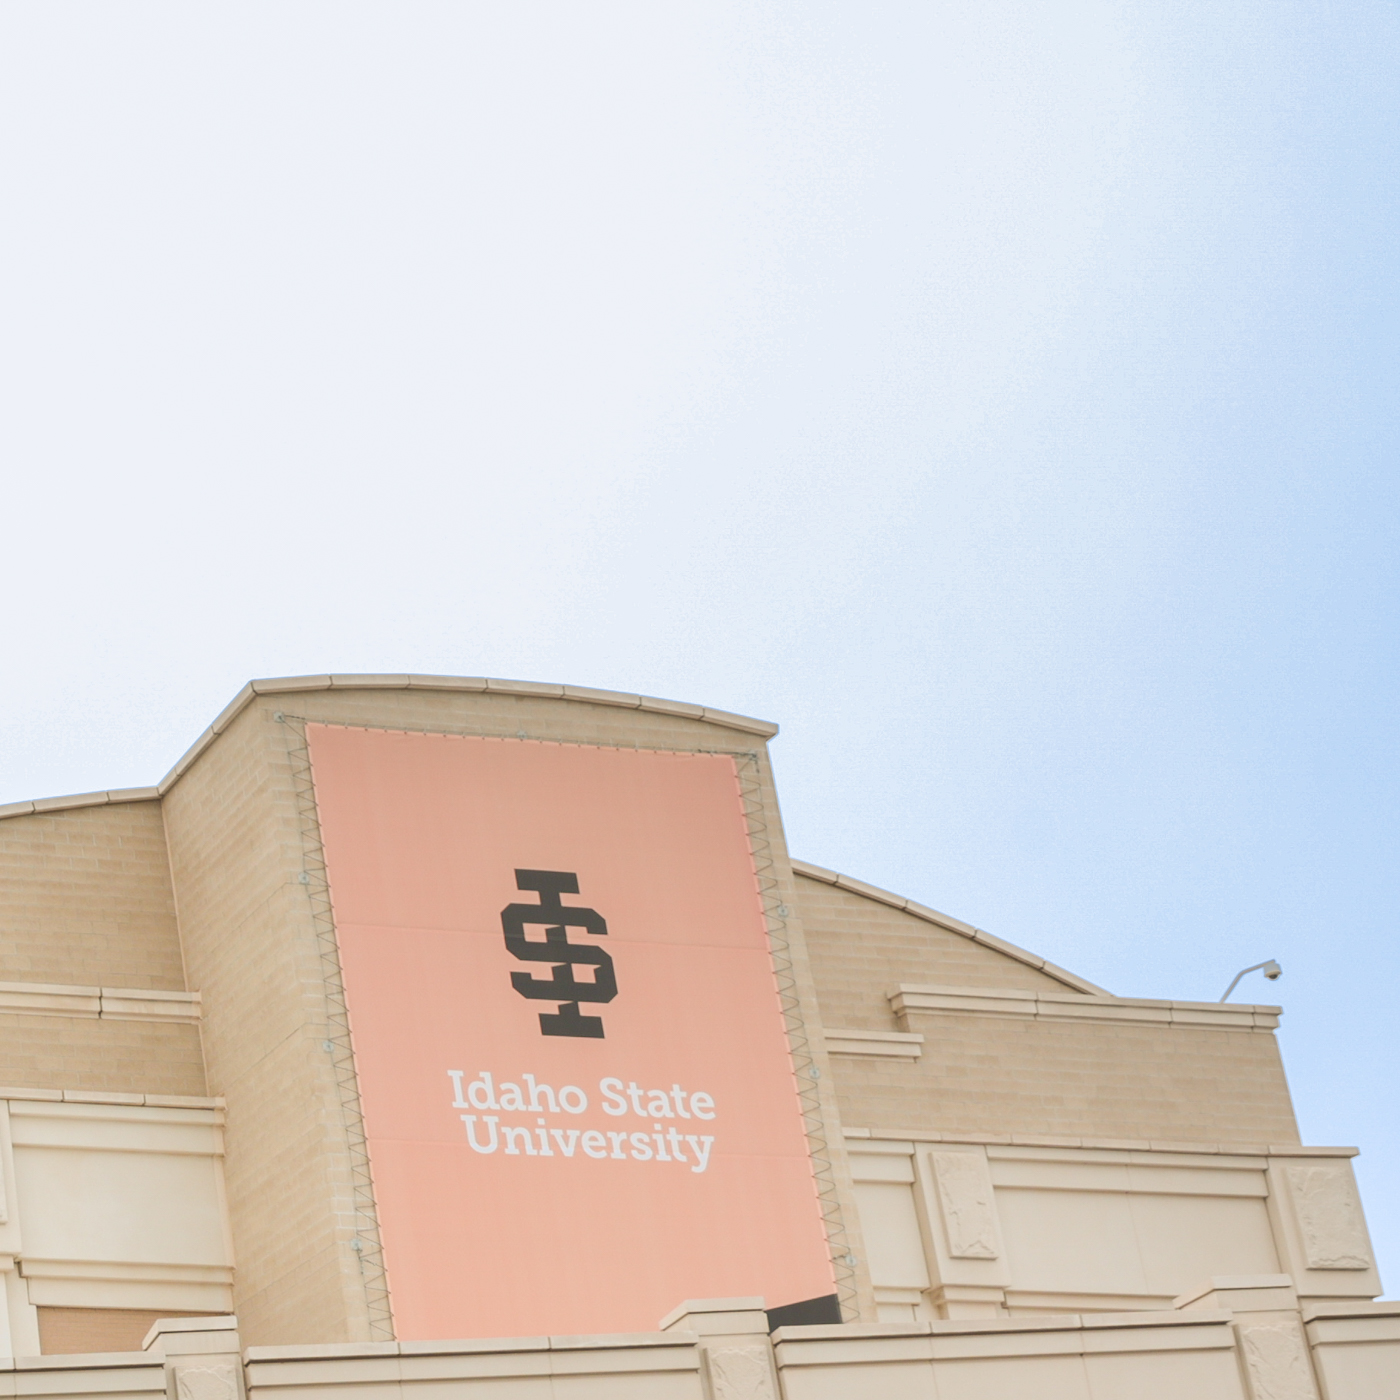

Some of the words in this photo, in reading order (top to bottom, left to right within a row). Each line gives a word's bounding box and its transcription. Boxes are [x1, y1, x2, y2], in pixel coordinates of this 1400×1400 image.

[447, 1069, 588, 1114] Idaho
[600, 1077, 717, 1121] State
[460, 1114, 715, 1174] University
